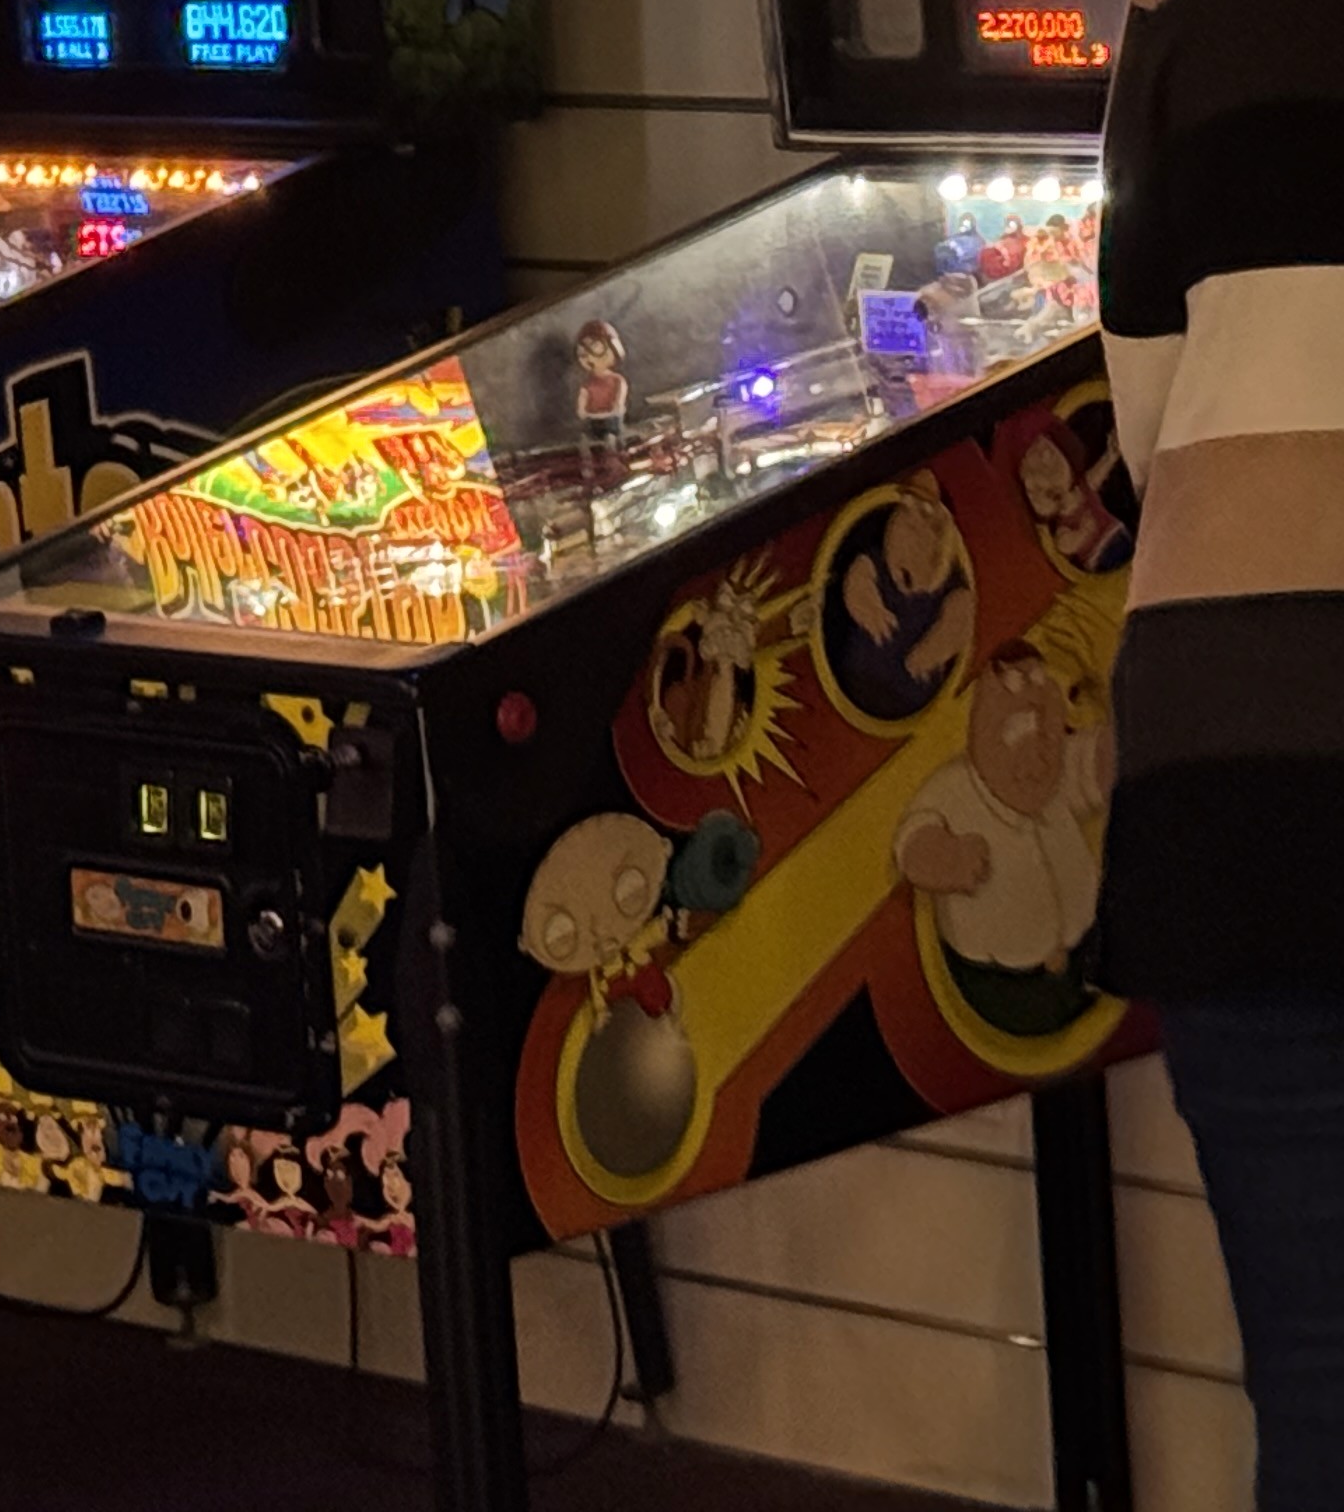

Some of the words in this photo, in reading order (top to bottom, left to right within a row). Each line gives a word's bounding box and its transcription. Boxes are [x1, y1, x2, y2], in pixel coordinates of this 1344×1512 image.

[978, 11, 1085, 41] 2,270,000
[191, 43, 232, 62] FREE
[236, 43, 275, 62] PLAY
